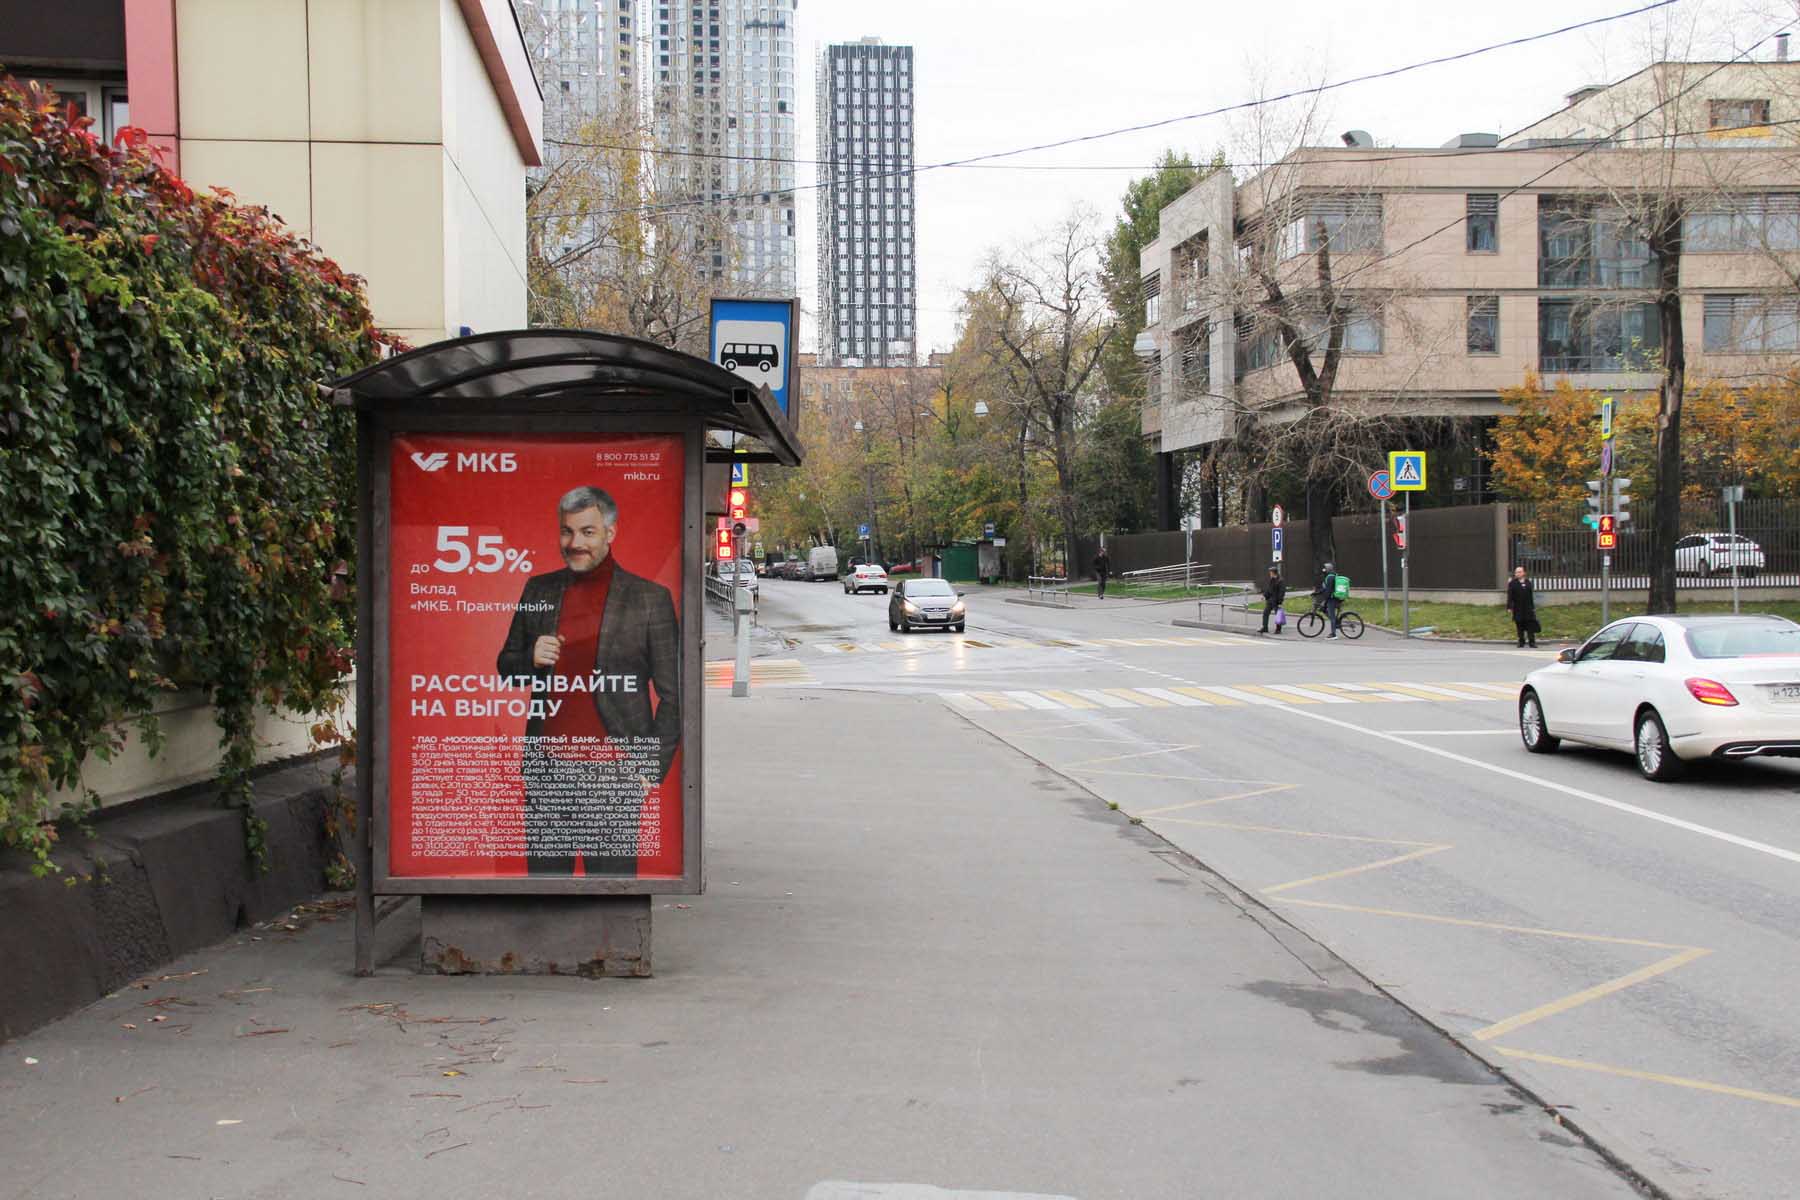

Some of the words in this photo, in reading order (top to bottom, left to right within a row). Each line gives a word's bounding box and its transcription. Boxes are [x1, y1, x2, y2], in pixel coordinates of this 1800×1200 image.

[456, 453, 518, 473] МКБ
[603, 453, 622, 461] 800
[624, 453, 639, 461] 775
[623, 471, 661, 481] mkb.ru
[410, 563, 430, 574] до
[410, 583, 456, 597] Вклад
[410, 600, 453, 613] «МКБ.
[456, 600, 555, 615] Практичный»
[410, 670, 638, 693] РАССЧИТЫВАЙТЕ
[410, 699, 447, 717] НА
[455, 699, 563, 720] ВЫГОДУ
